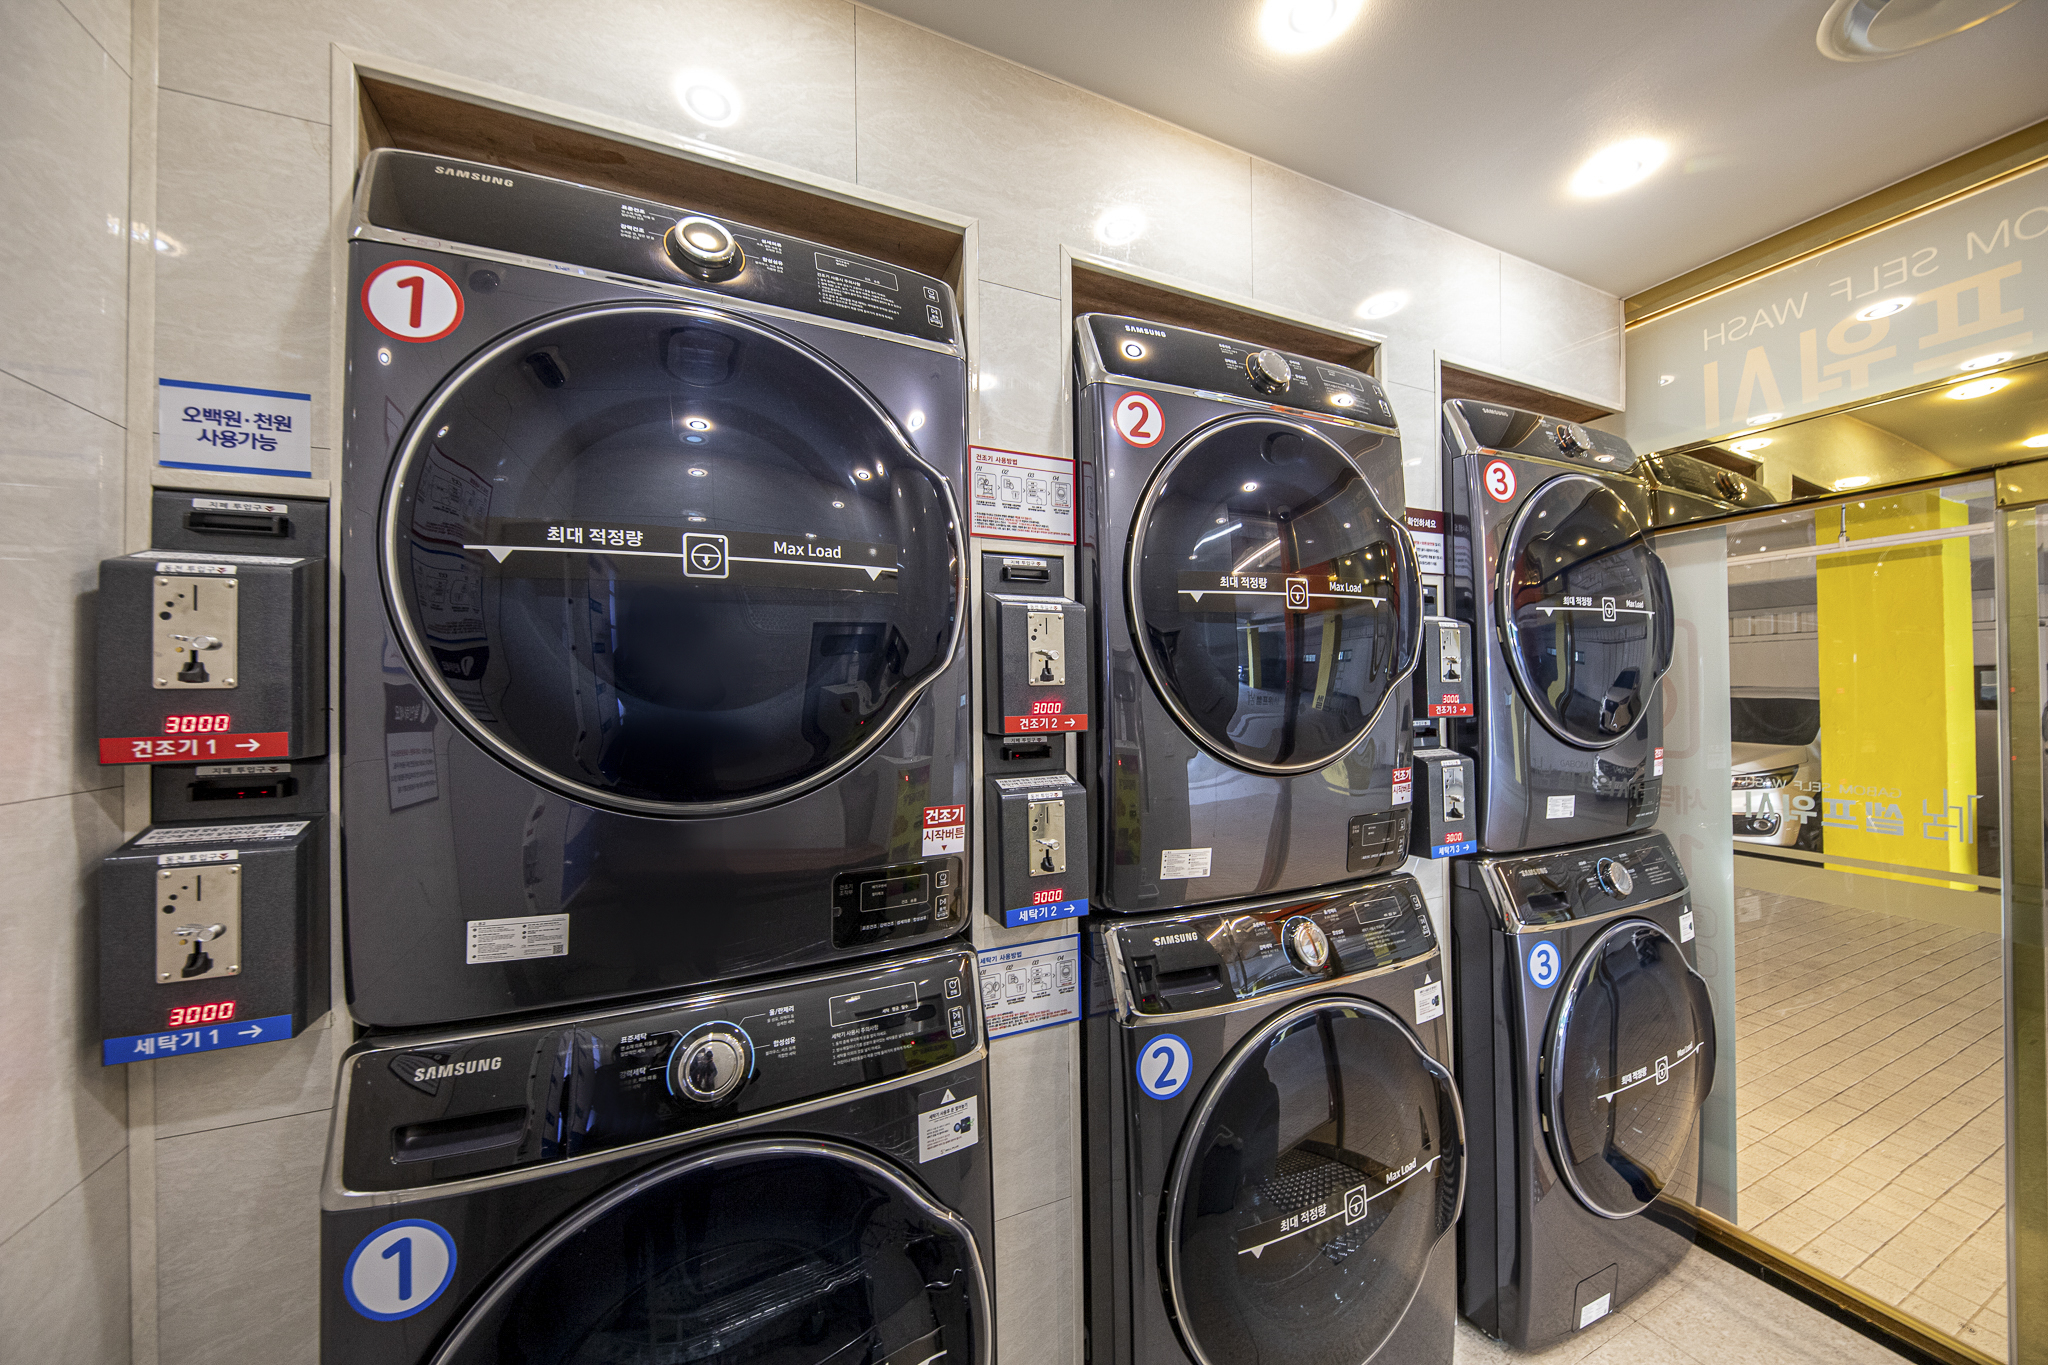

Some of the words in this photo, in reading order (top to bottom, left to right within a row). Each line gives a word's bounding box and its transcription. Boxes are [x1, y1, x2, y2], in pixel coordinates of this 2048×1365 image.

[434, 165, 514, 188] SAMSUNG
[396, 275, 425, 329] 1
[1124, 324, 1167, 338] SAMSUNG
[1127, 401, 1151, 439] 2
[1481, 407, 1509, 418] SAMSUNG
[196, 428, 278, 452] 사용가능
[975, 454, 993, 462] 건조기
[996, 456, 1018, 466] 사용방법
[1494, 467, 1509, 495] 3
[1406, 516, 1437, 529] 확인하세요
[546, 525, 583, 545] 최대
[588, 527, 644, 548] 적정량
[773, 541, 806, 557] Max
[808, 543, 842, 560] Load
[1219, 576, 1239, 588] 최대
[1240, 576, 1268, 589] 적정량
[1329, 581, 1345, 592] Max
[1345, 582, 1362, 593] Load
[1442, 694, 1460, 704] 3000
[1033, 702, 1062, 714] 3000
[1435, 706, 1452, 714] 건조기
[1452, 706, 1458, 714] 3
[164, 714, 231, 734] 3000
[1019, 718, 1049, 730] 건조기
[1051, 718, 1058, 728] 2
[131, 739, 198, 758] 건조기
[206, 739, 216, 755] 1
[1392, 769, 1412, 782] 건조기
[925, 806, 964, 825] 건조기
[924, 826, 965, 842] 시작버튼
[1446, 832, 1463, 843] 3000
[1438, 846, 1455, 855] 세탁기
[1456, 845, 1460, 853] 3
[1034, 890, 1063, 904] 3000
[1018, 908, 1048, 922] 세탁기
[1050, 906, 1057, 917] 2
[1154, 931, 1198, 947] SAMSUNG
[980, 956, 998, 964] 세탁기
[1000, 951, 1022, 961] 사용방법
[1536, 949, 1552, 976] 3
[168, 1001, 236, 1027] 3000
[134, 1032, 200, 1055] 세탁기
[208, 1029, 219, 1044] 1
[620, 1032, 648, 1044] 표준세탁
[414, 1056, 502, 1083] SAMSUNG
[1152, 1046, 1177, 1089] 2
[1386, 1168, 1400, 1184] Max
[1400, 1158, 1417, 1176] Load
[1280, 1216, 1299, 1232] 최대
[1300, 1202, 1327, 1224] 적정량
[382, 1236, 412, 1301] 1
